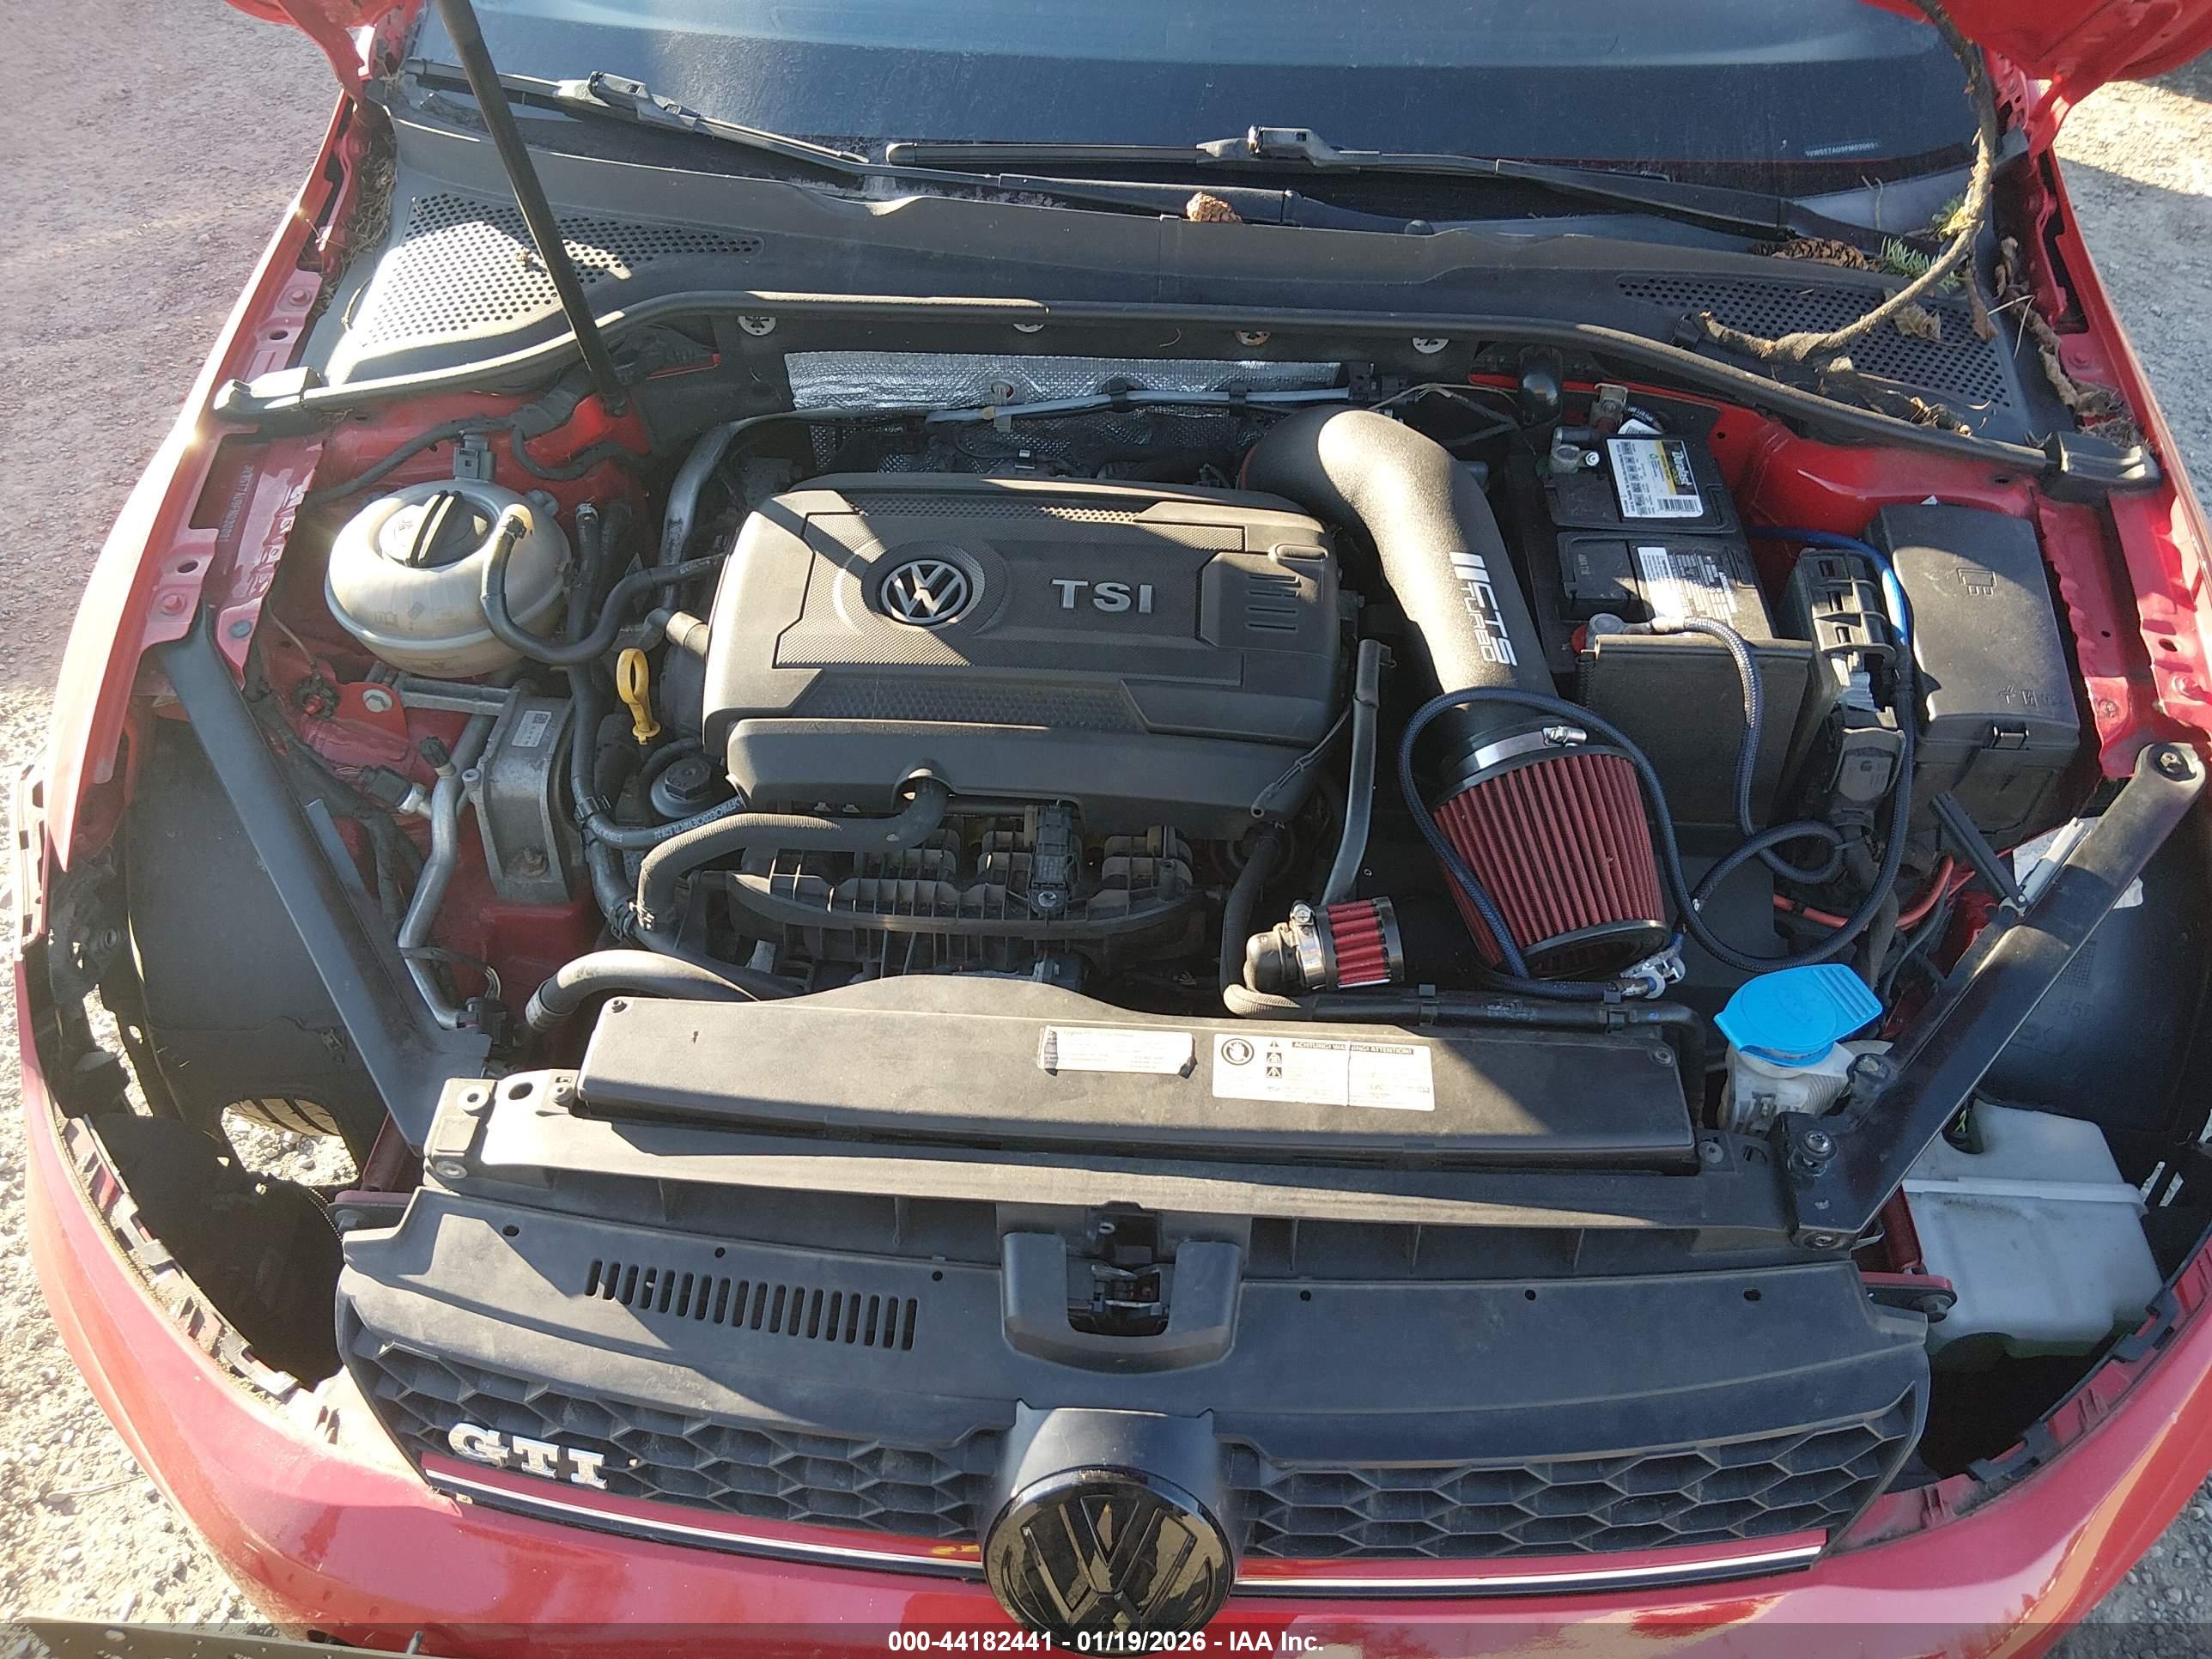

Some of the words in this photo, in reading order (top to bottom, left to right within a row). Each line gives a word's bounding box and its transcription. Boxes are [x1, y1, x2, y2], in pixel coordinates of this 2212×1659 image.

[1671, 450, 1692, 486] Duralast
[1052, 579, 1154, 614] TSI
[1460, 580, 1497, 662] TURBO
[1471, 581, 1518, 667] CTS
[1333, 1043, 1369, 1052] WAING!
[1370, 1046, 1413, 1054] ATTENTION!
[447, 1422, 608, 1490] GTI
